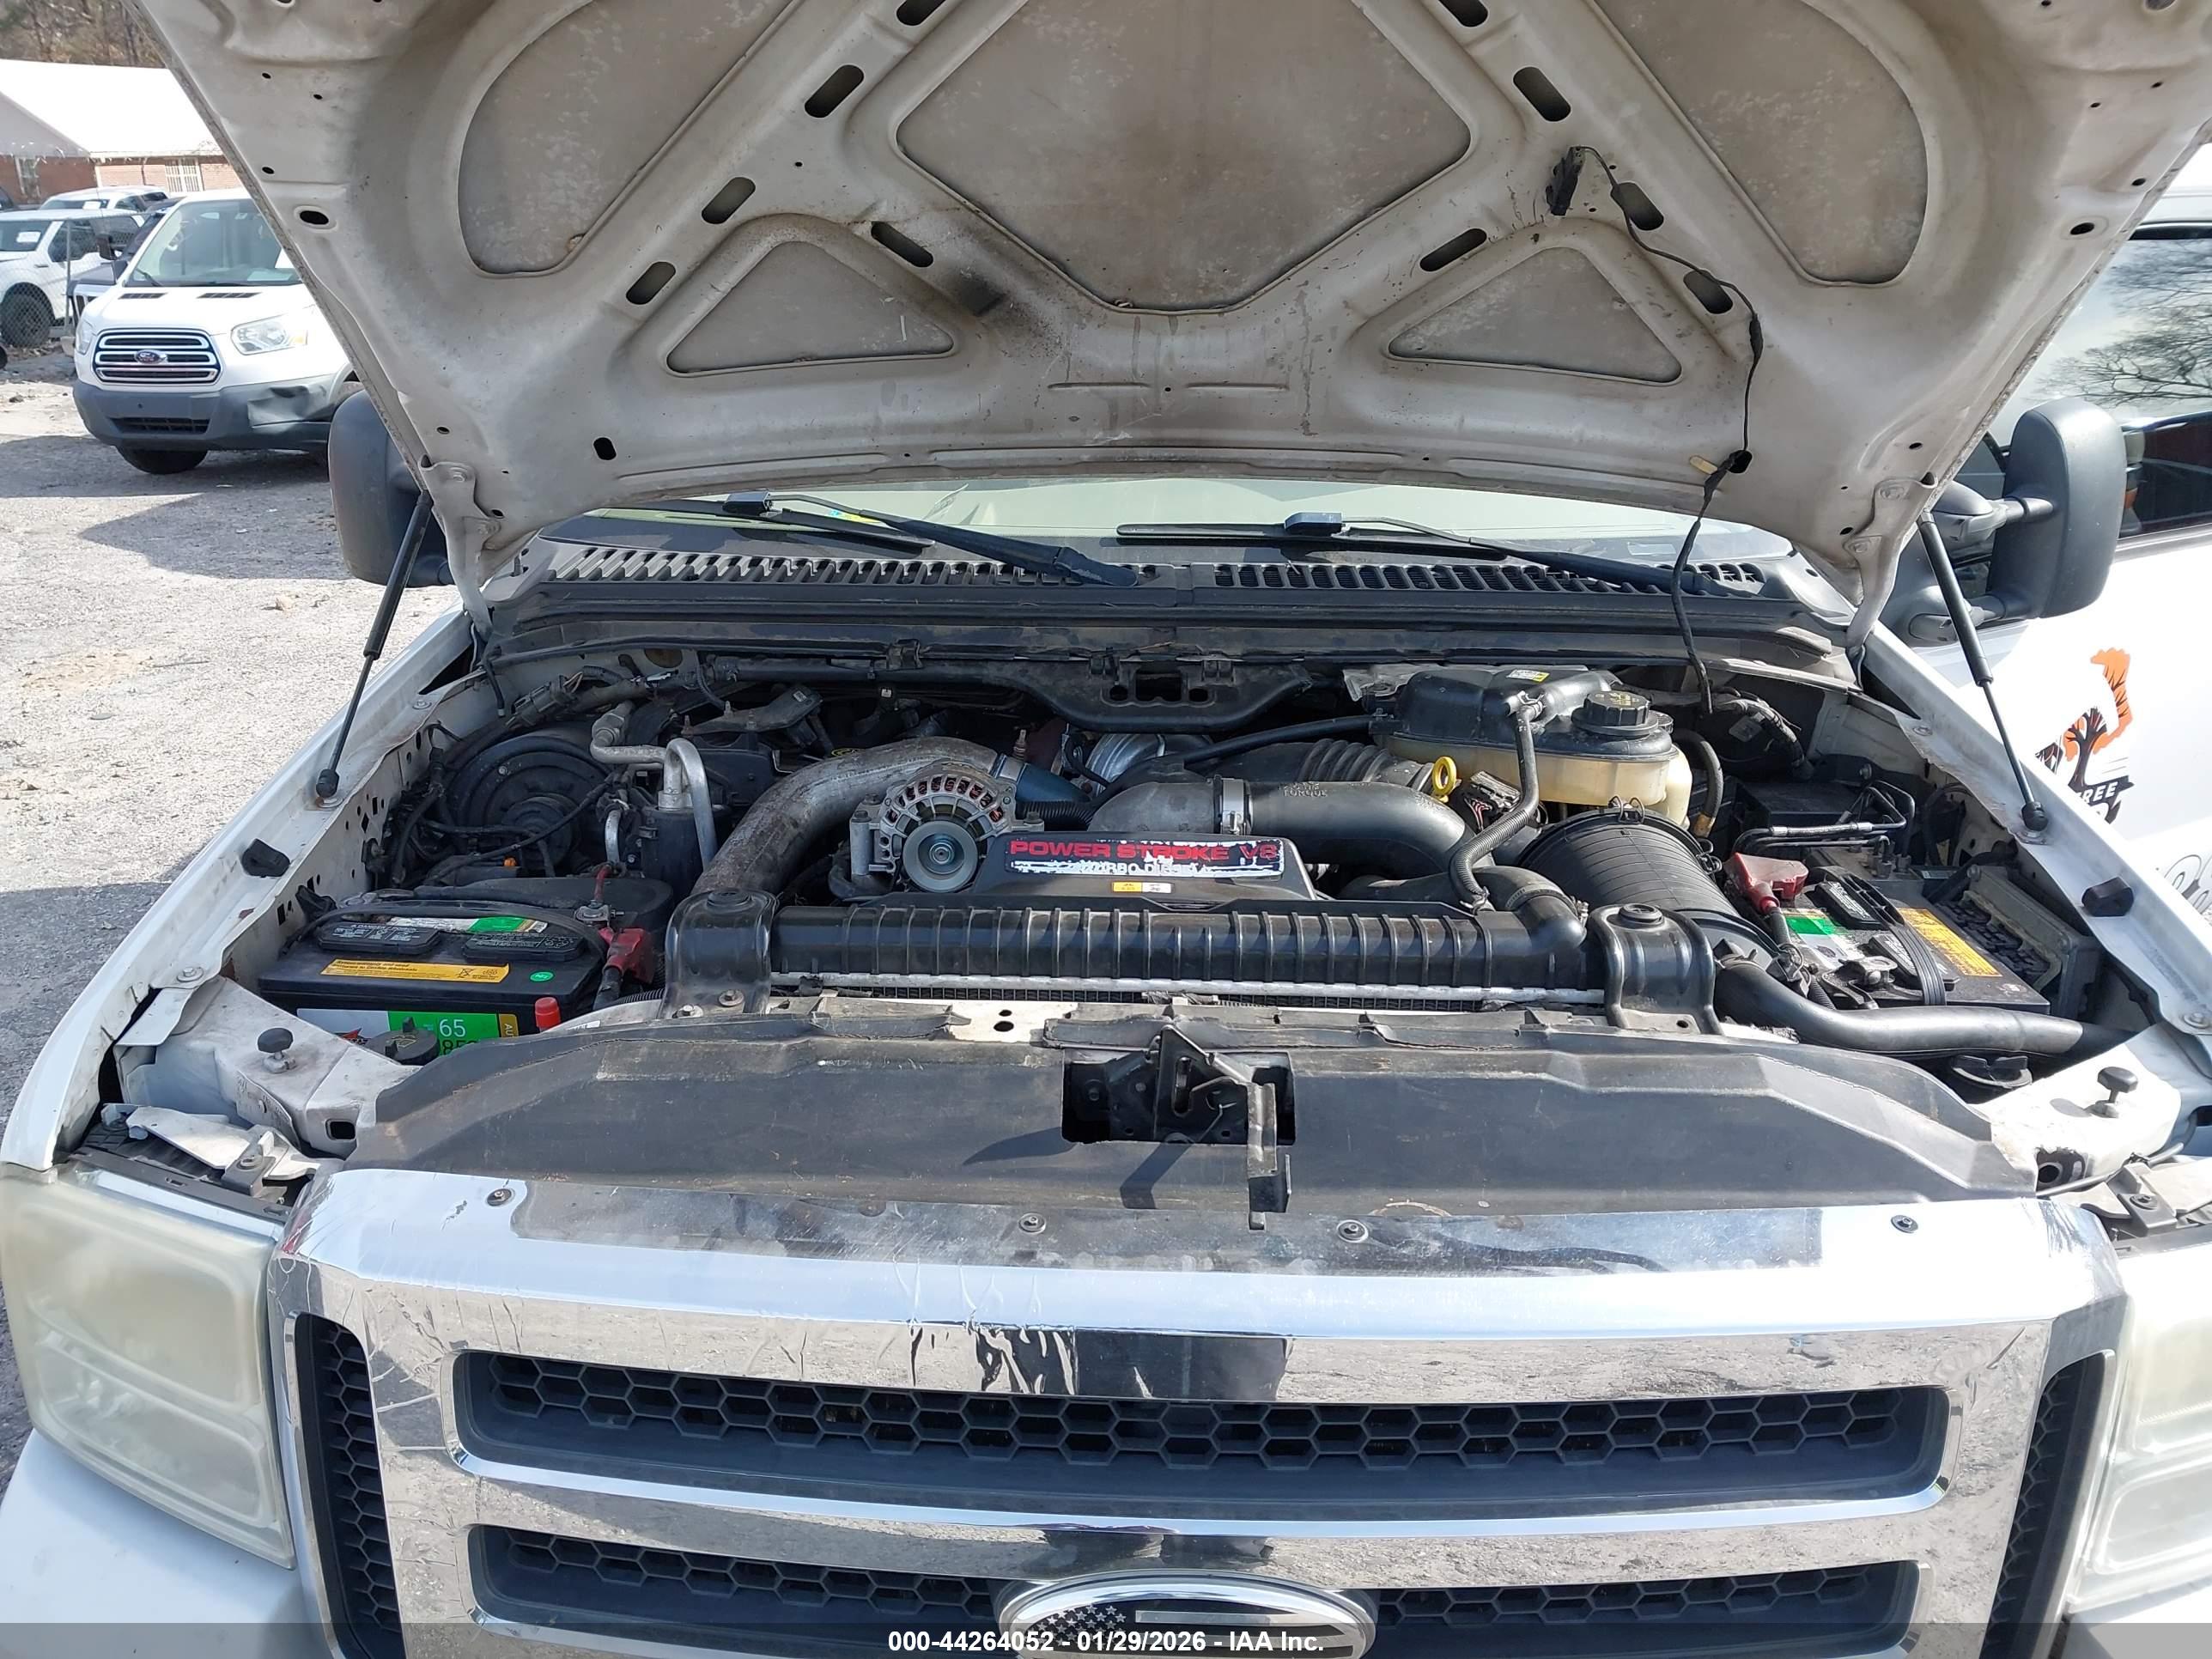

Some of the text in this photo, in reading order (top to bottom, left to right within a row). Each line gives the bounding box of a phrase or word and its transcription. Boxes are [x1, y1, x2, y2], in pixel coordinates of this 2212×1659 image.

[2076, 781, 2118, 804] REE
[1010, 841, 1278, 860] POWER STROKE V8
[439, 1018, 466, 1037] 65
[504, 1023, 514, 1037] AU
